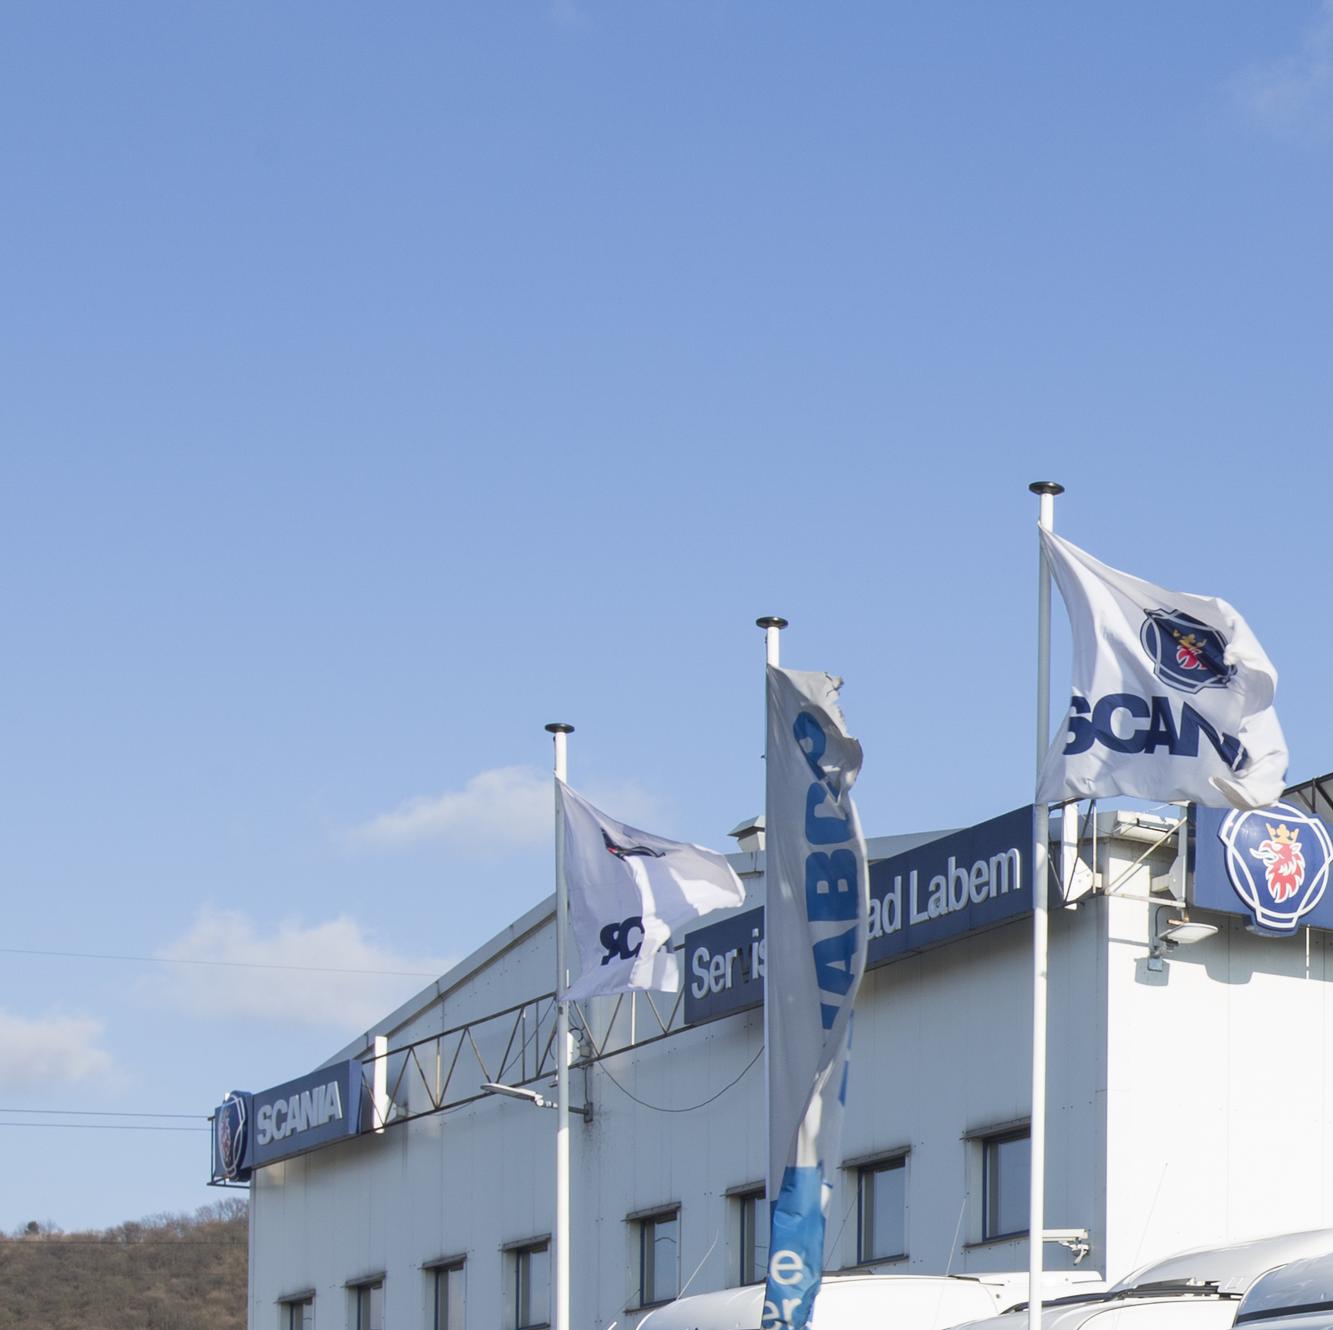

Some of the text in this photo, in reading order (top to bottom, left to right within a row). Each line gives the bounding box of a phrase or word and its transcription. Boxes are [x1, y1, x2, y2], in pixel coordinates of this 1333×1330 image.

[1063, 693, 1249, 772] SCAN
[867, 876, 902, 940] ad
[909, 848, 1021, 926] Labem
[257, 1080, 342, 1146] SCANIA
